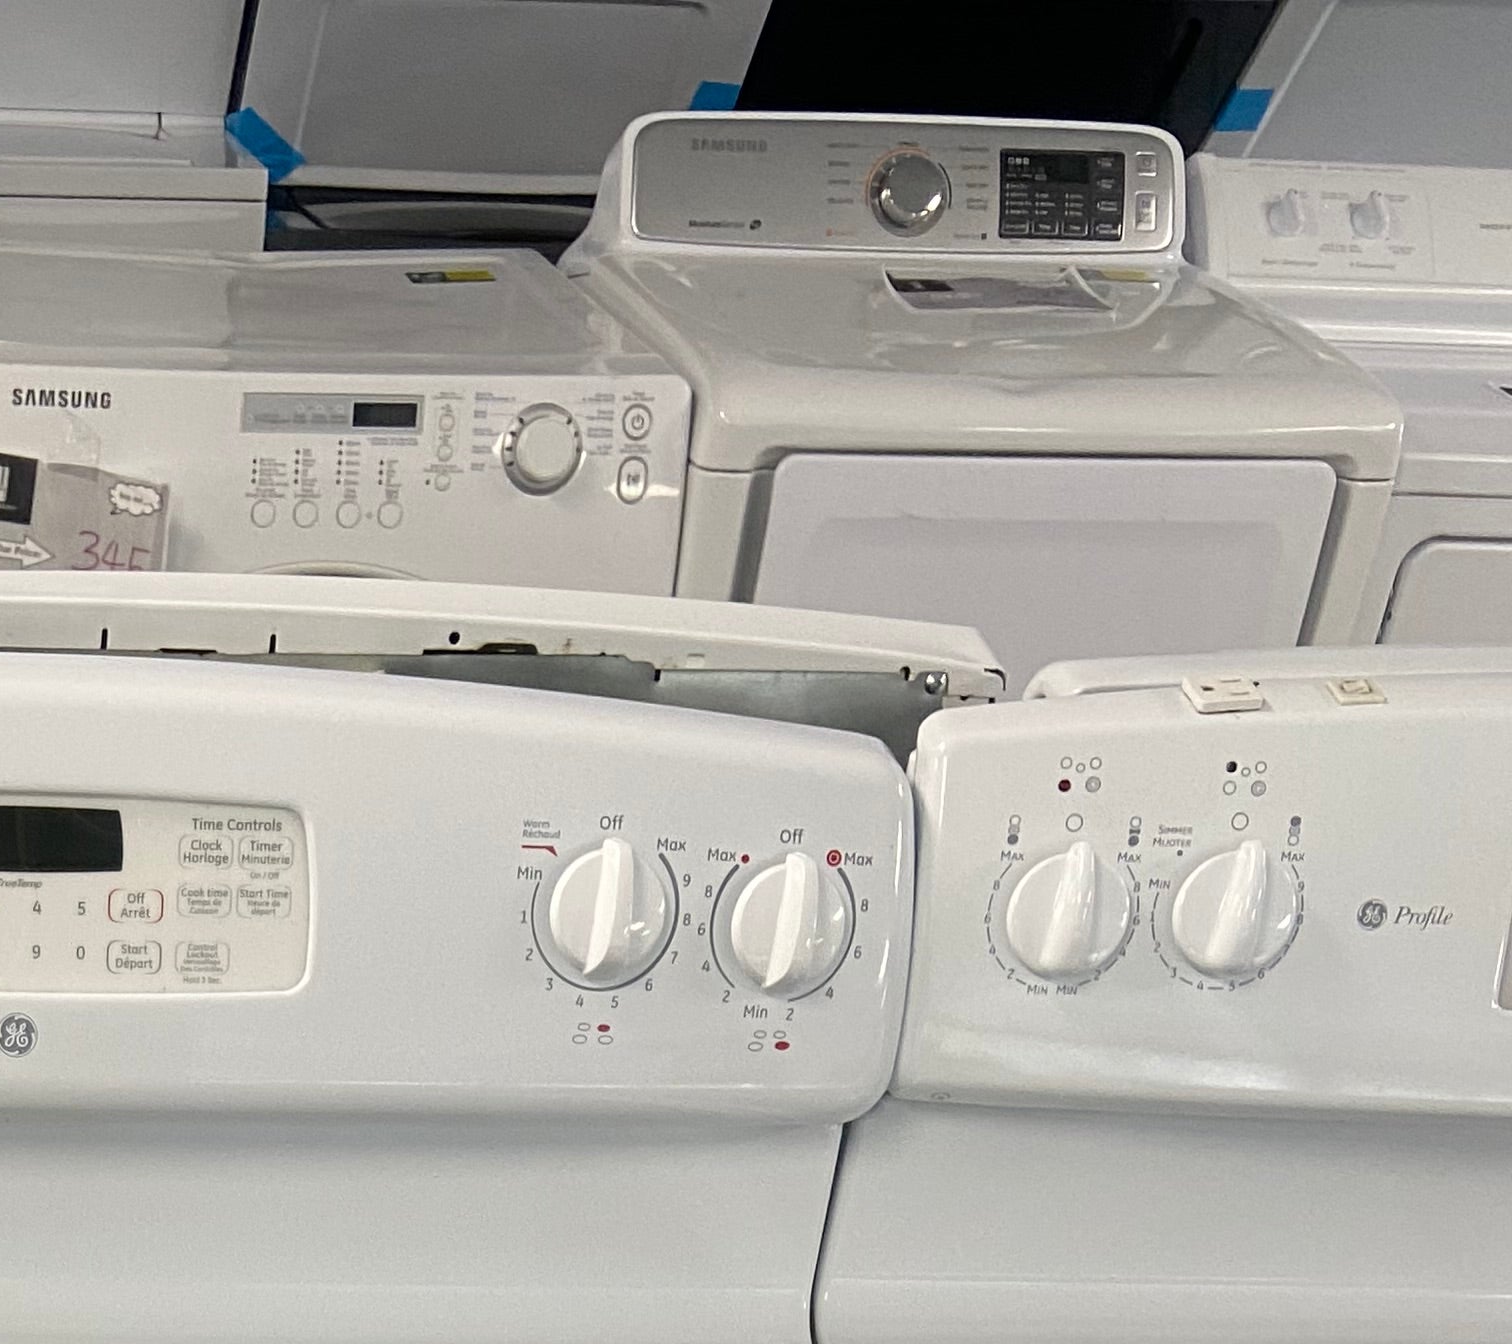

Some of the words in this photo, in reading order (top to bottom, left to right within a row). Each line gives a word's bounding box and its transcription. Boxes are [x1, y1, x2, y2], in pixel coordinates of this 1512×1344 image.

[12, 388, 112, 410] SAMSUNG
[192, 818, 223, 831] Time
[227, 818, 283, 832] Controls
[599, 815, 624, 831] Off
[780, 829, 804, 845] Off
[191, 839, 222, 851] Clock
[250, 840, 283, 852] Timer
[657, 837, 687, 852] Max
[183, 853, 229, 866] Horloge
[241, 853, 290, 866] Minuterie
[707, 848, 736, 863] Max
[844, 853, 873, 868] Max
[517, 867, 542, 881] Min
[683, 874, 691, 887] 9
[705, 885, 713, 898] 8
[993, 880, 1000, 890] 8
[1134, 882, 1140, 892] 8
[1297, 882, 1305, 892] 9
[127, 892, 145, 904] Off
[181, 888, 205, 899] Cook
[208, 887, 228, 898] time
[240, 888, 263, 899] Start
[266, 888, 288, 899] Time
[32, 901, 42, 916] 4
[77, 901, 87, 916] 5
[120, 906, 150, 919] Arrêt
[860, 899, 869, 913] 8
[520, 910, 527, 924] 1
[683, 913, 691, 927] 8
[984, 914, 991, 923] 6
[1133, 916, 1140, 925] 6
[1394, 905, 1454, 931] Profile
[697, 922, 706, 936] 6
[32, 945, 42, 960] 9
[76, 945, 86, 960] 0
[121, 943, 148, 955] Start
[525, 948, 533, 961] 2
[853, 945, 862, 959] 6
[1153, 942, 1161, 953] 2
[115, 956, 153, 970] Départ
[670, 951, 679, 965] 7
[702, 959, 711, 973] 4
[1007, 969, 1015, 979] 2
[1094, 970, 1101, 980] 2
[1258, 968, 1265, 979] 6
[545, 978, 553, 991] 3
[645, 978, 653, 992] 6
[1196, 981, 1204, 991] 4
[722, 990, 730, 1004] 2
[826, 985, 834, 999] 4
[576, 994, 584, 1008] 4
[611, 996, 619, 1009] 5
[743, 1004, 768, 1019] Min
[786, 1008, 794, 1022] 2
